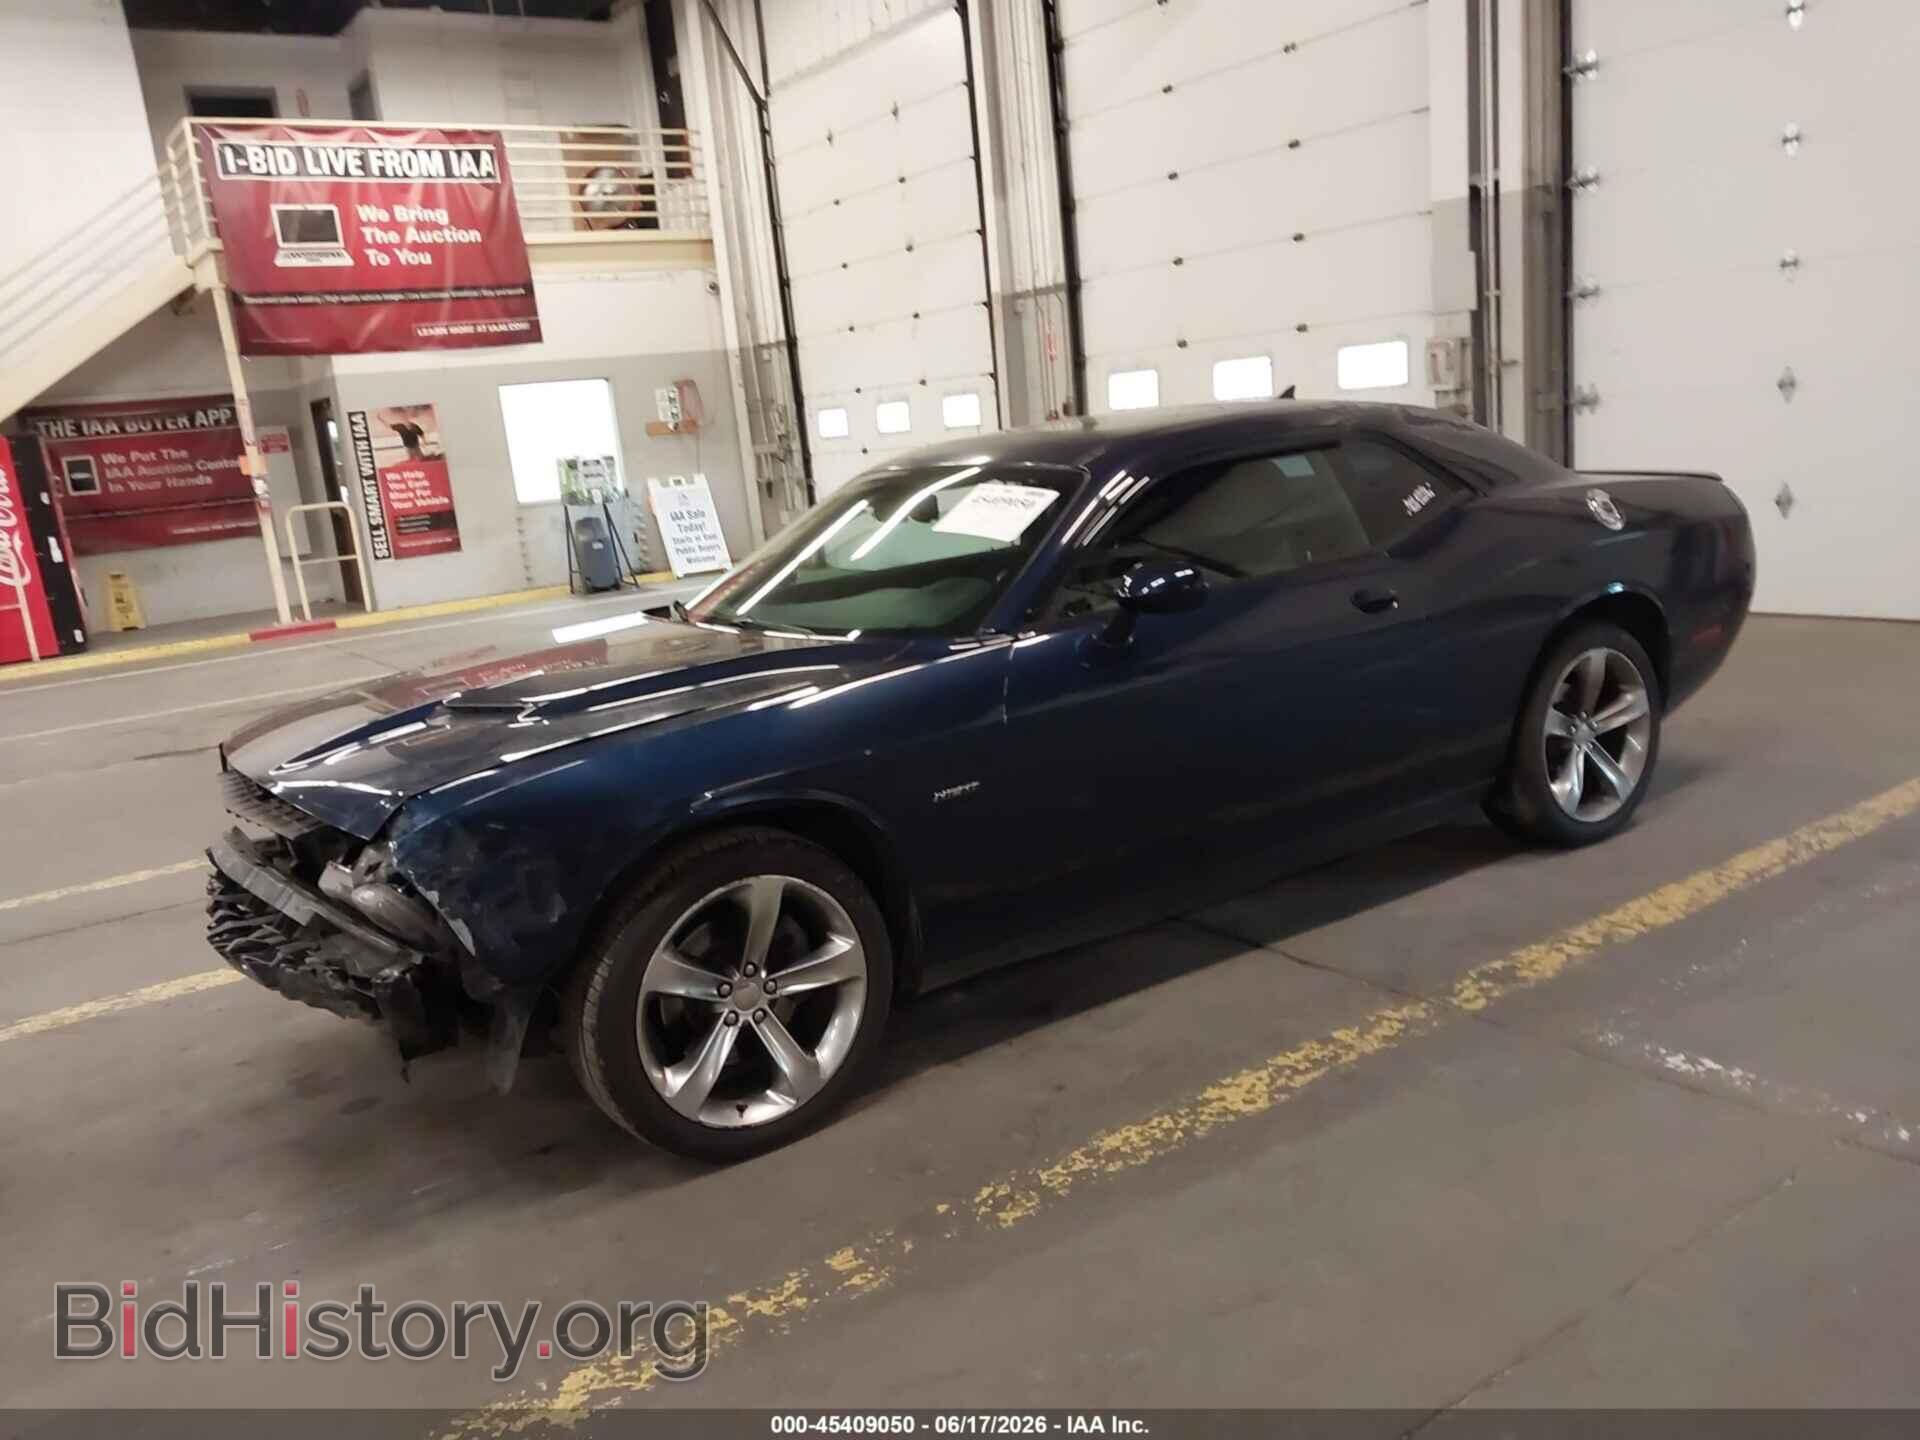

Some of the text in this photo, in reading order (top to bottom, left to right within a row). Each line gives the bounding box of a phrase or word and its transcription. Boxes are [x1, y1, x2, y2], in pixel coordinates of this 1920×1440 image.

[224, 145, 495, 179] I-BID LIVE FROM IAA
[357, 204, 449, 226] We Bring
[360, 226, 482, 245] The Auction
[364, 249, 432, 266] To You
[39, 421, 78, 439] THE
[83, 419, 122, 437] IAA
[195, 409, 233, 426] APP
[102, 448, 189, 465] We Put The
[105, 466, 135, 479] IAA
[138, 461, 194, 477] Auction
[108, 475, 213, 494] In Your Hands
[351, 413, 390, 559] SELL SMART WITH IAA
